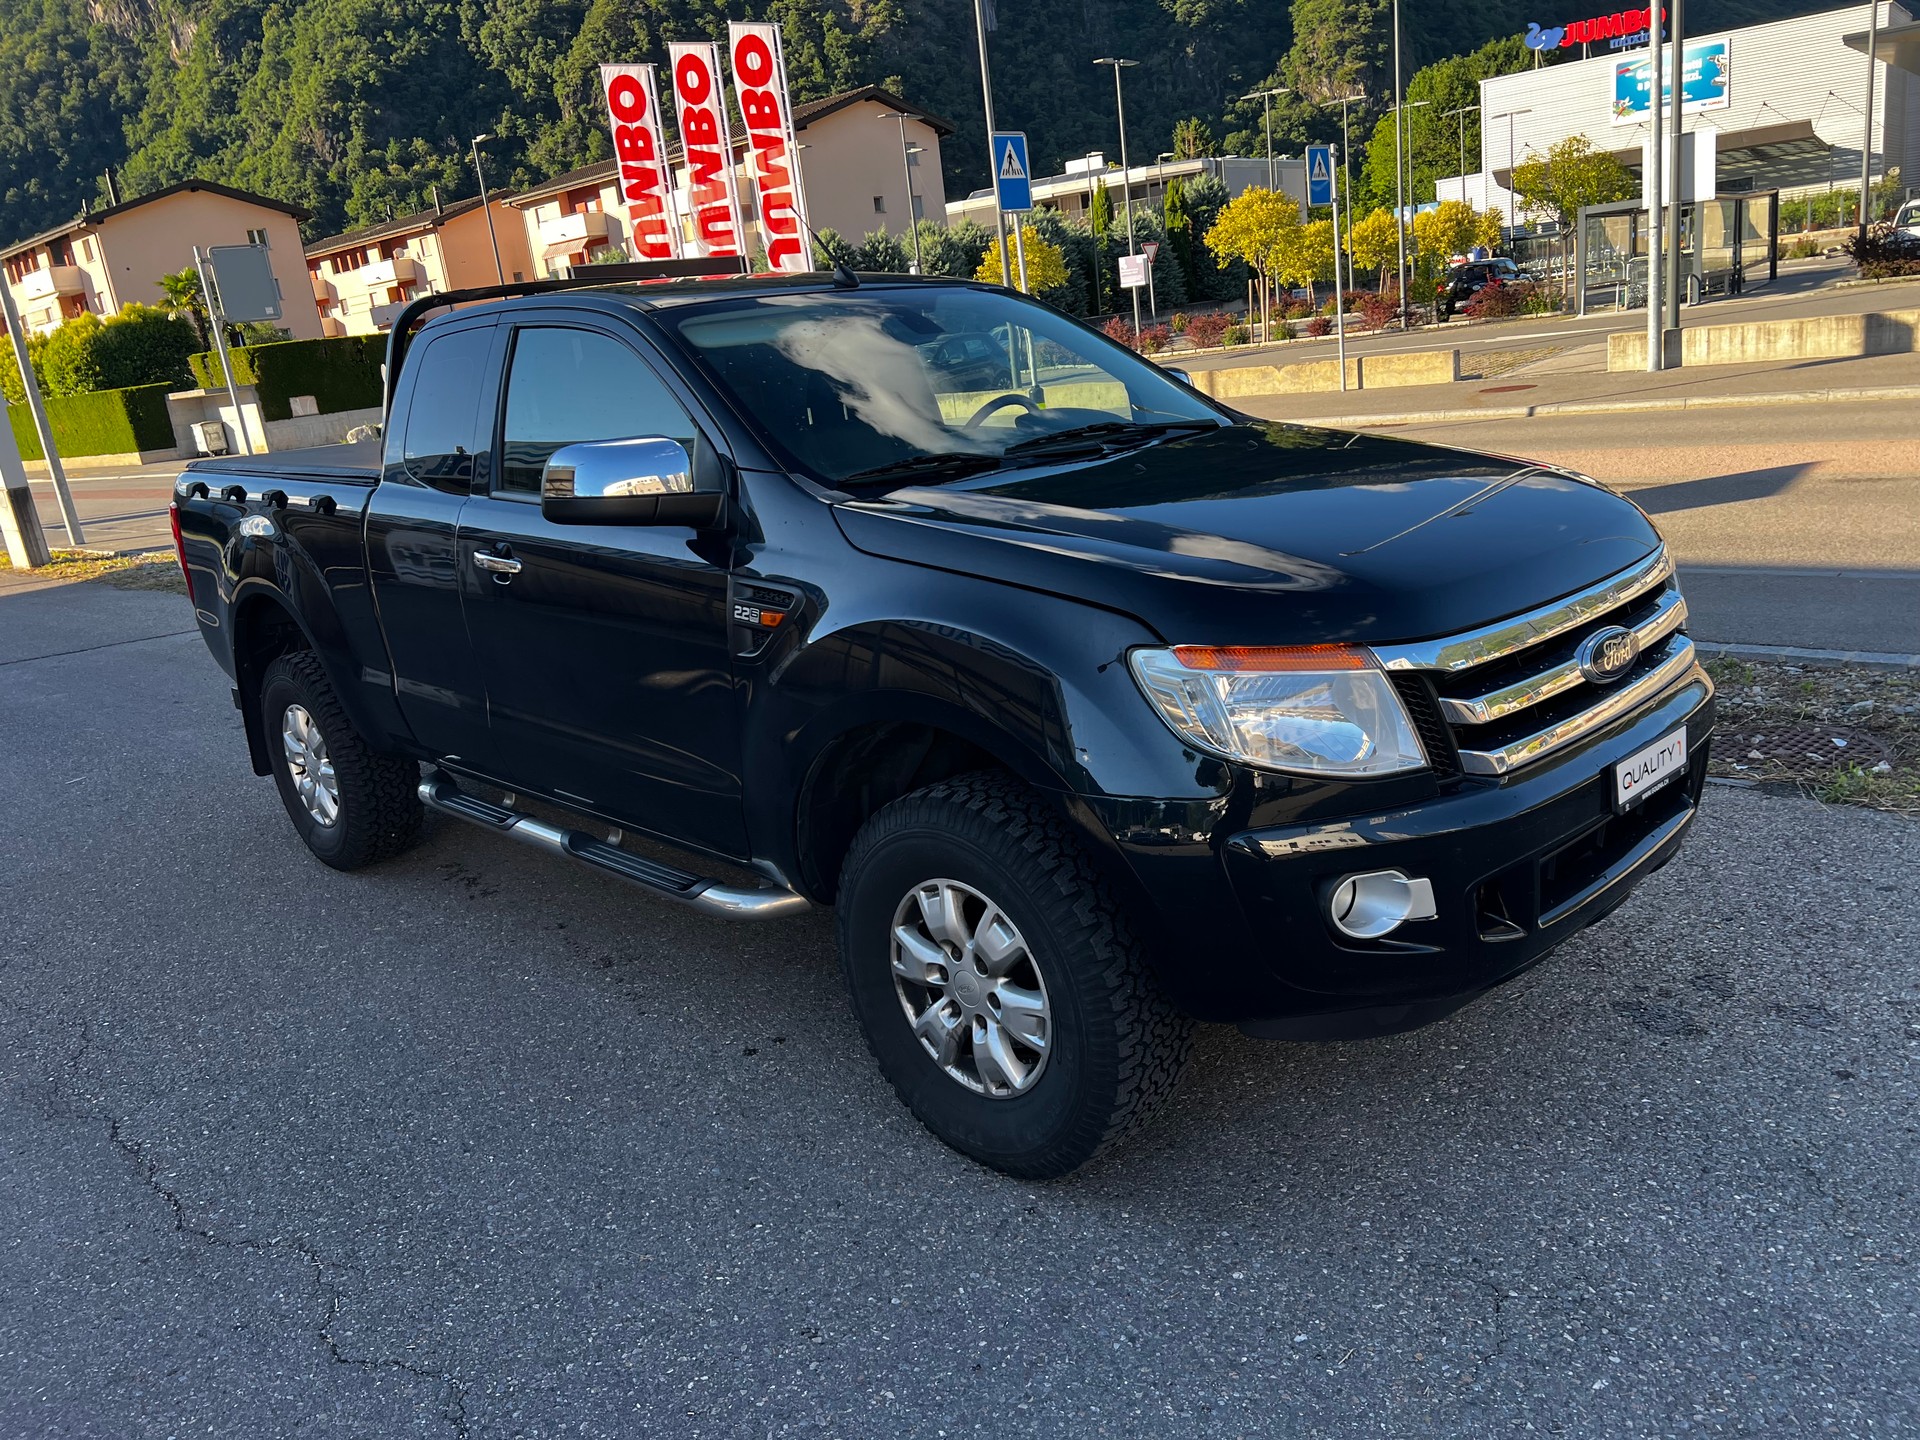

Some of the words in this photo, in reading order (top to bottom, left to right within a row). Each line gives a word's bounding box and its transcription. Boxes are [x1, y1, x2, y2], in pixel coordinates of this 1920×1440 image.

[608, 74, 672, 258] UMBO
[676, 53, 737, 257] UMBO
[734, 34, 801, 268] JUMBO
[1603, 635, 1632, 671] Ford
